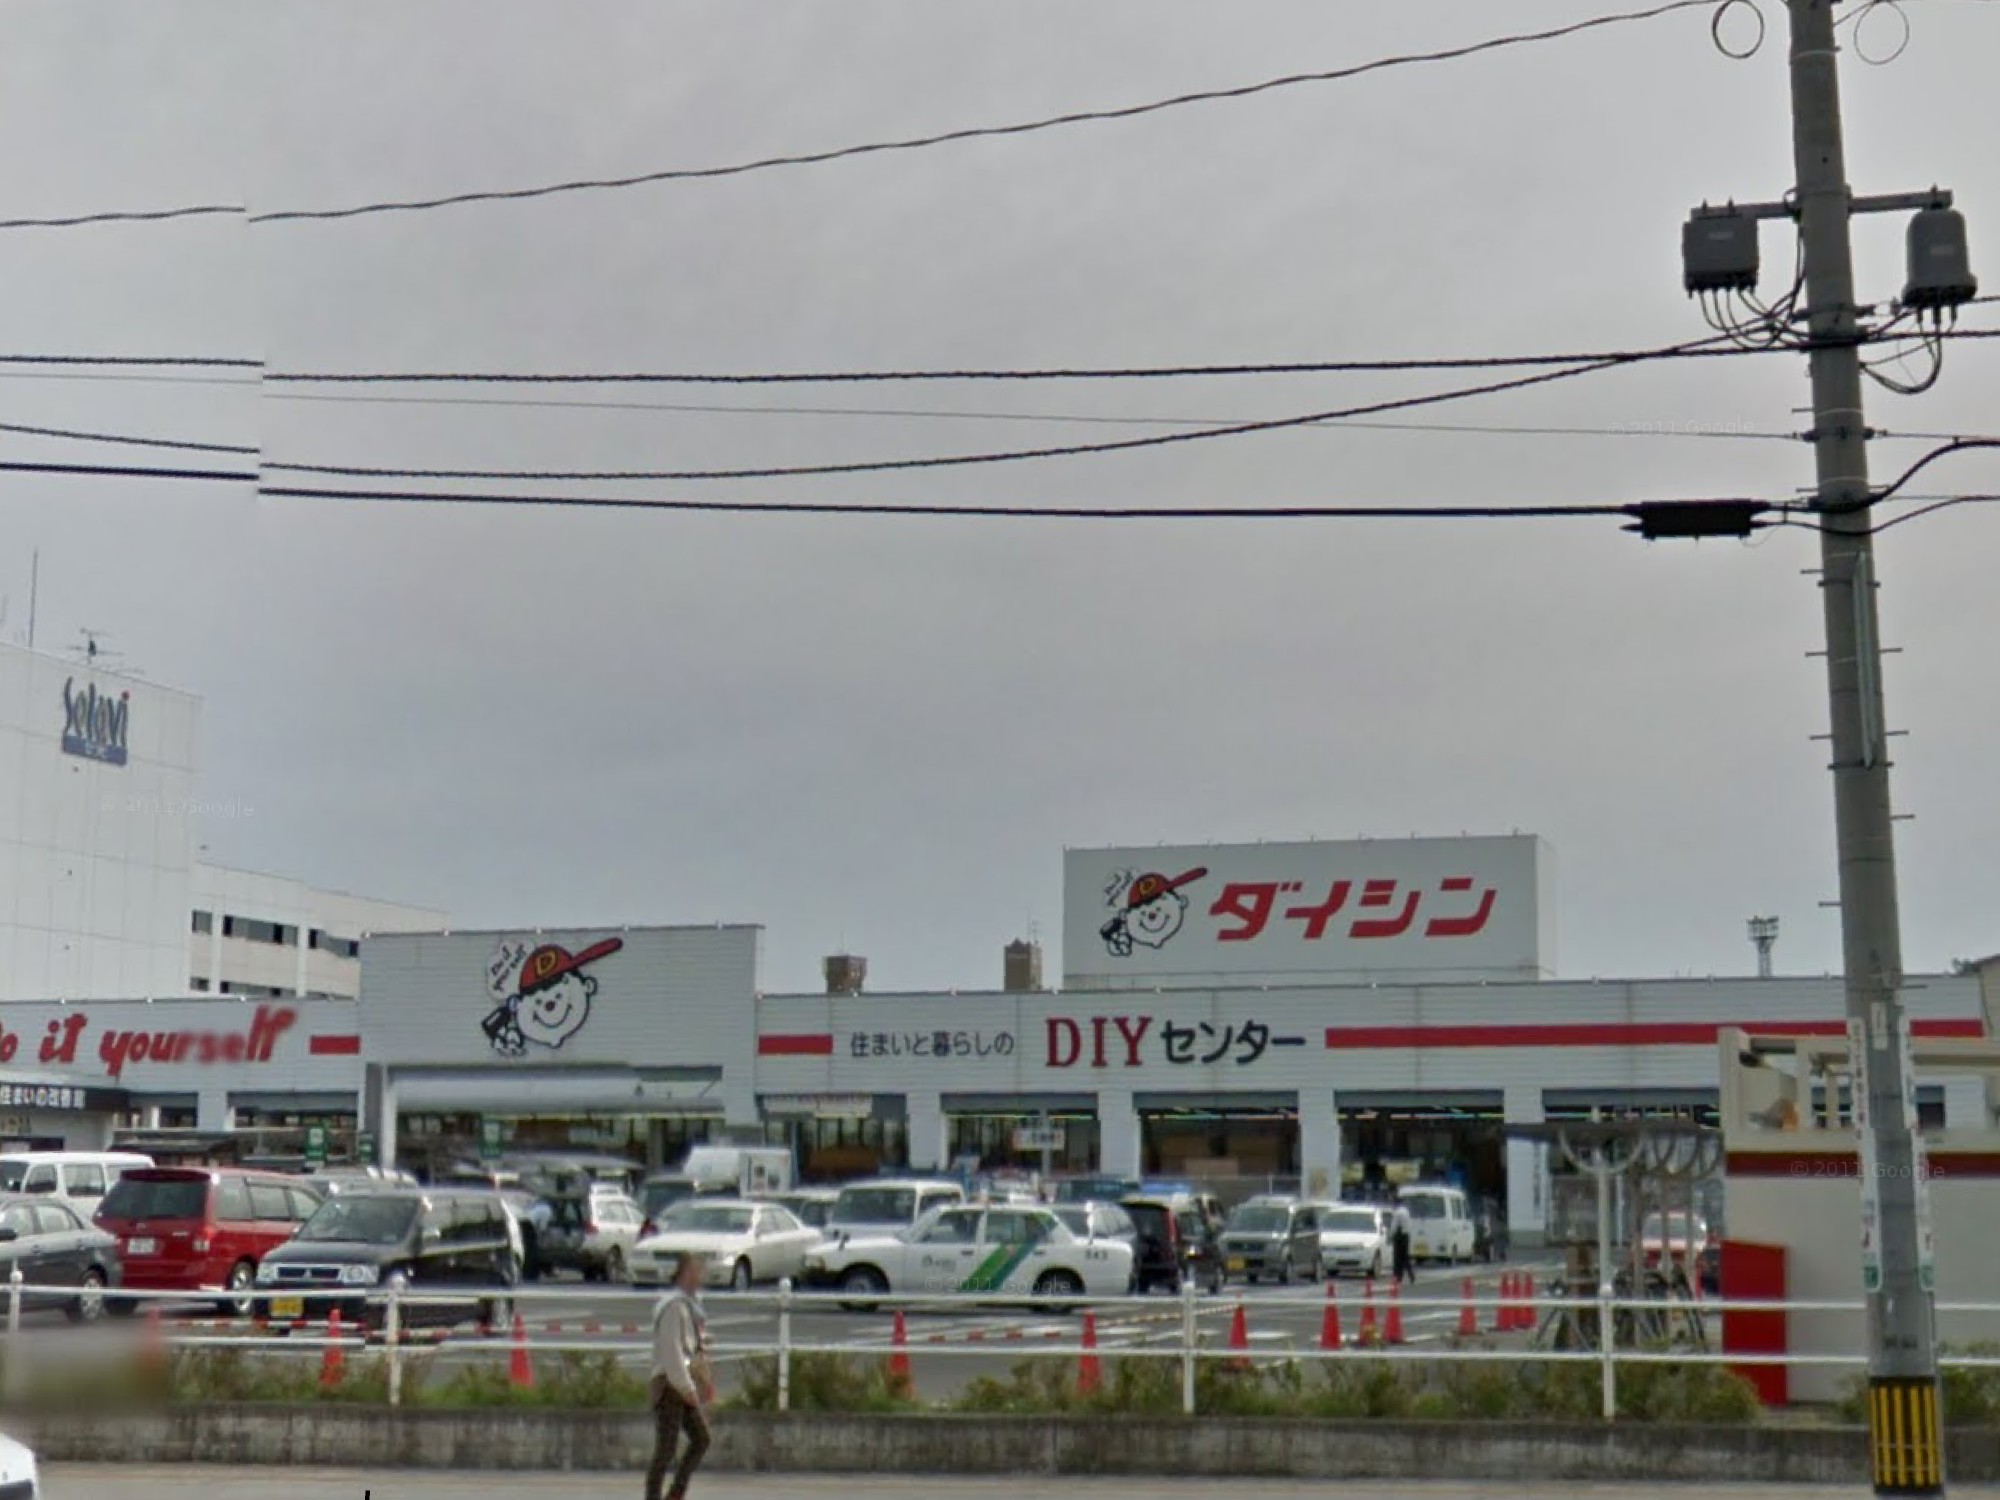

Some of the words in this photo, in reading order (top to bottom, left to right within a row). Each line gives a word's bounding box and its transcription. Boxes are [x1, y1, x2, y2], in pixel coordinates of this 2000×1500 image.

[1208, 877, 1497, 942] ダイシン
[536, 949, 558, 977] D
[0, 1020, 18, 1063] o
[39, 1012, 88, 1063] it
[98, 1004, 298, 1077] yourself
[849, 1029, 1015, 1059] 住まいと暮らしの
